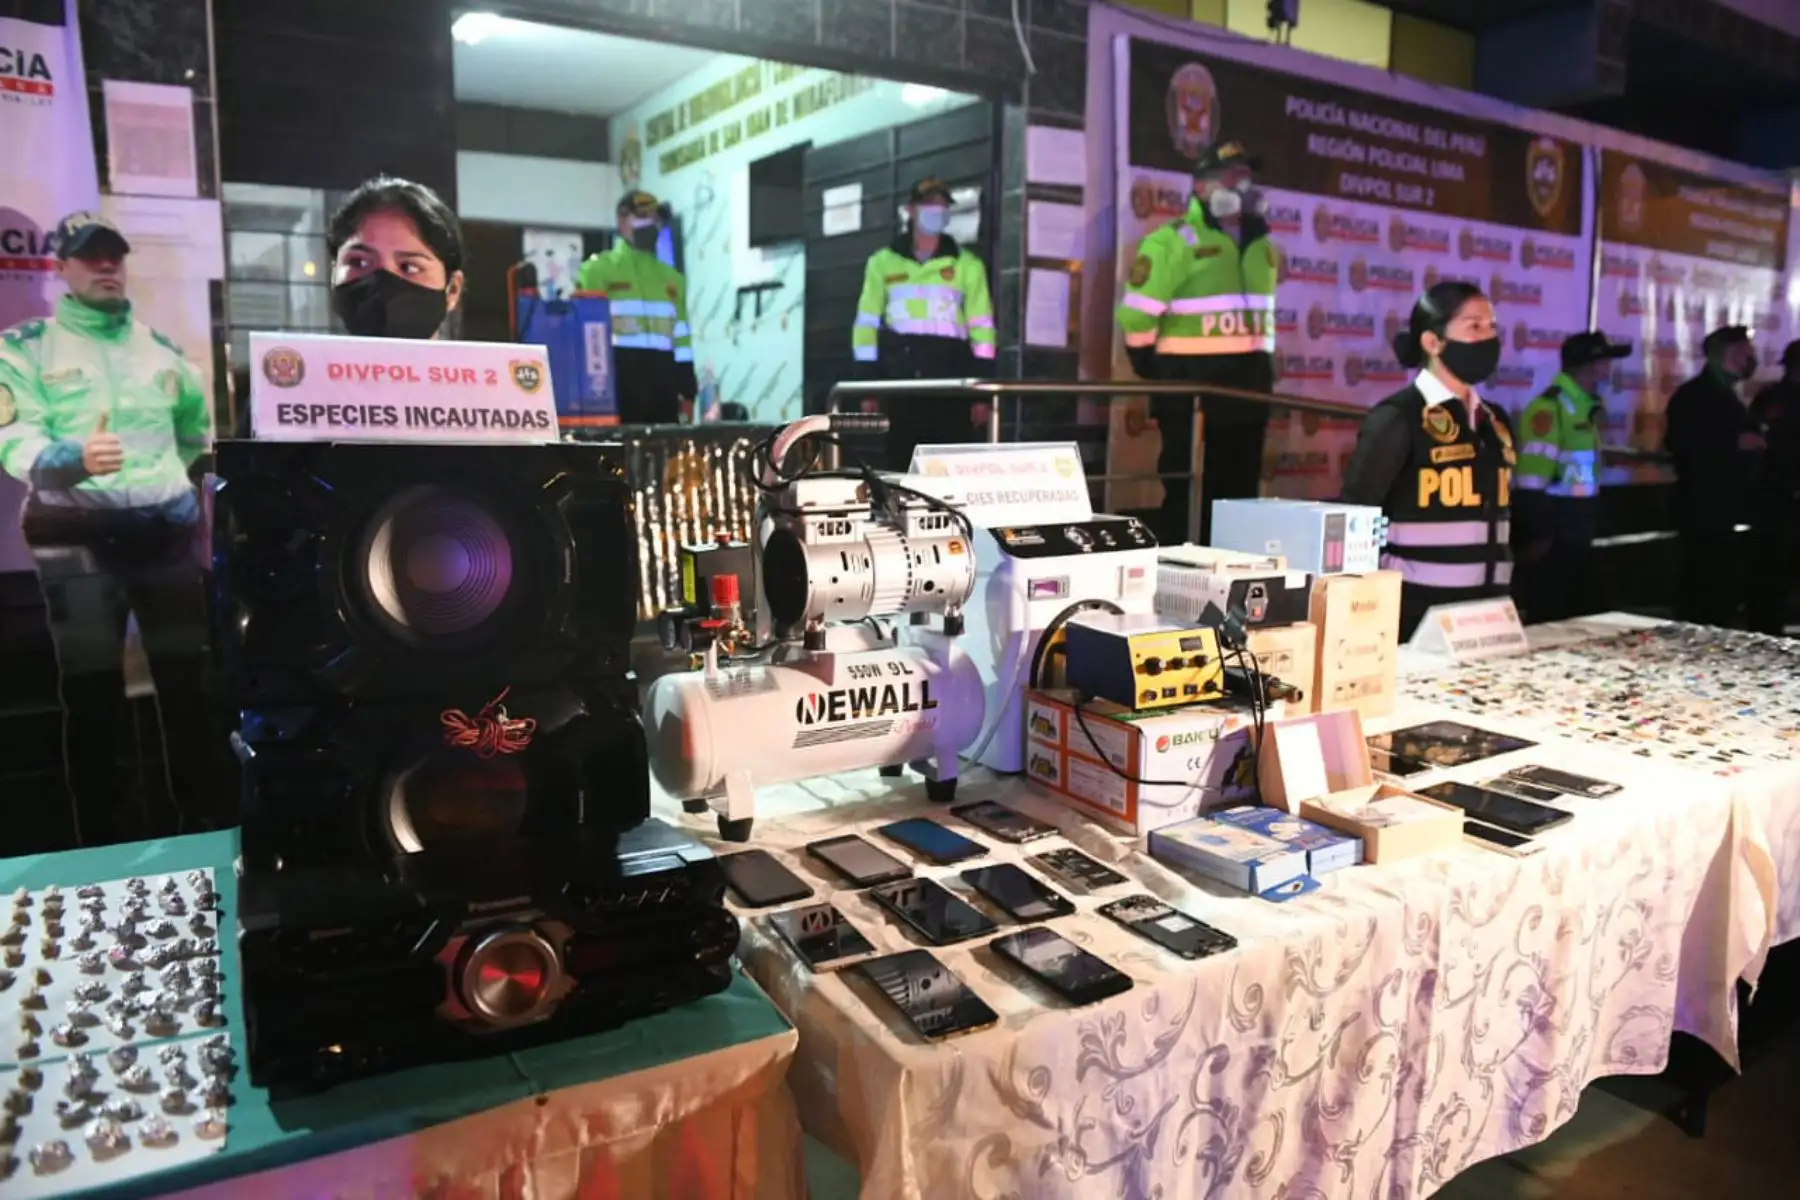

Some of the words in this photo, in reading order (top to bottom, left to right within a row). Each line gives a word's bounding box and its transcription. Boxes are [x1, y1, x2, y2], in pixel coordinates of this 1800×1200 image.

[1348, 110, 1420, 143] NACIONAL
[1424, 127, 1447, 149] DEL
[1368, 146, 1428, 175] POLICIAL
[1431, 160, 1465, 181] LIMA
[1340, 172, 1392, 200] DIVPOL
[327, 363, 420, 383] DIVPOL
[428, 366, 476, 383] SUR
[483, 369, 497, 385] 2
[277, 403, 398, 426] ESPECIES
[405, 406, 550, 428] INCAUTADAS
[998, 489, 1079, 504] RECUPERADAS
[847, 662, 883, 680] 550W
[888, 661, 913, 676] 9L
[796, 680, 937, 725] NEWALL
